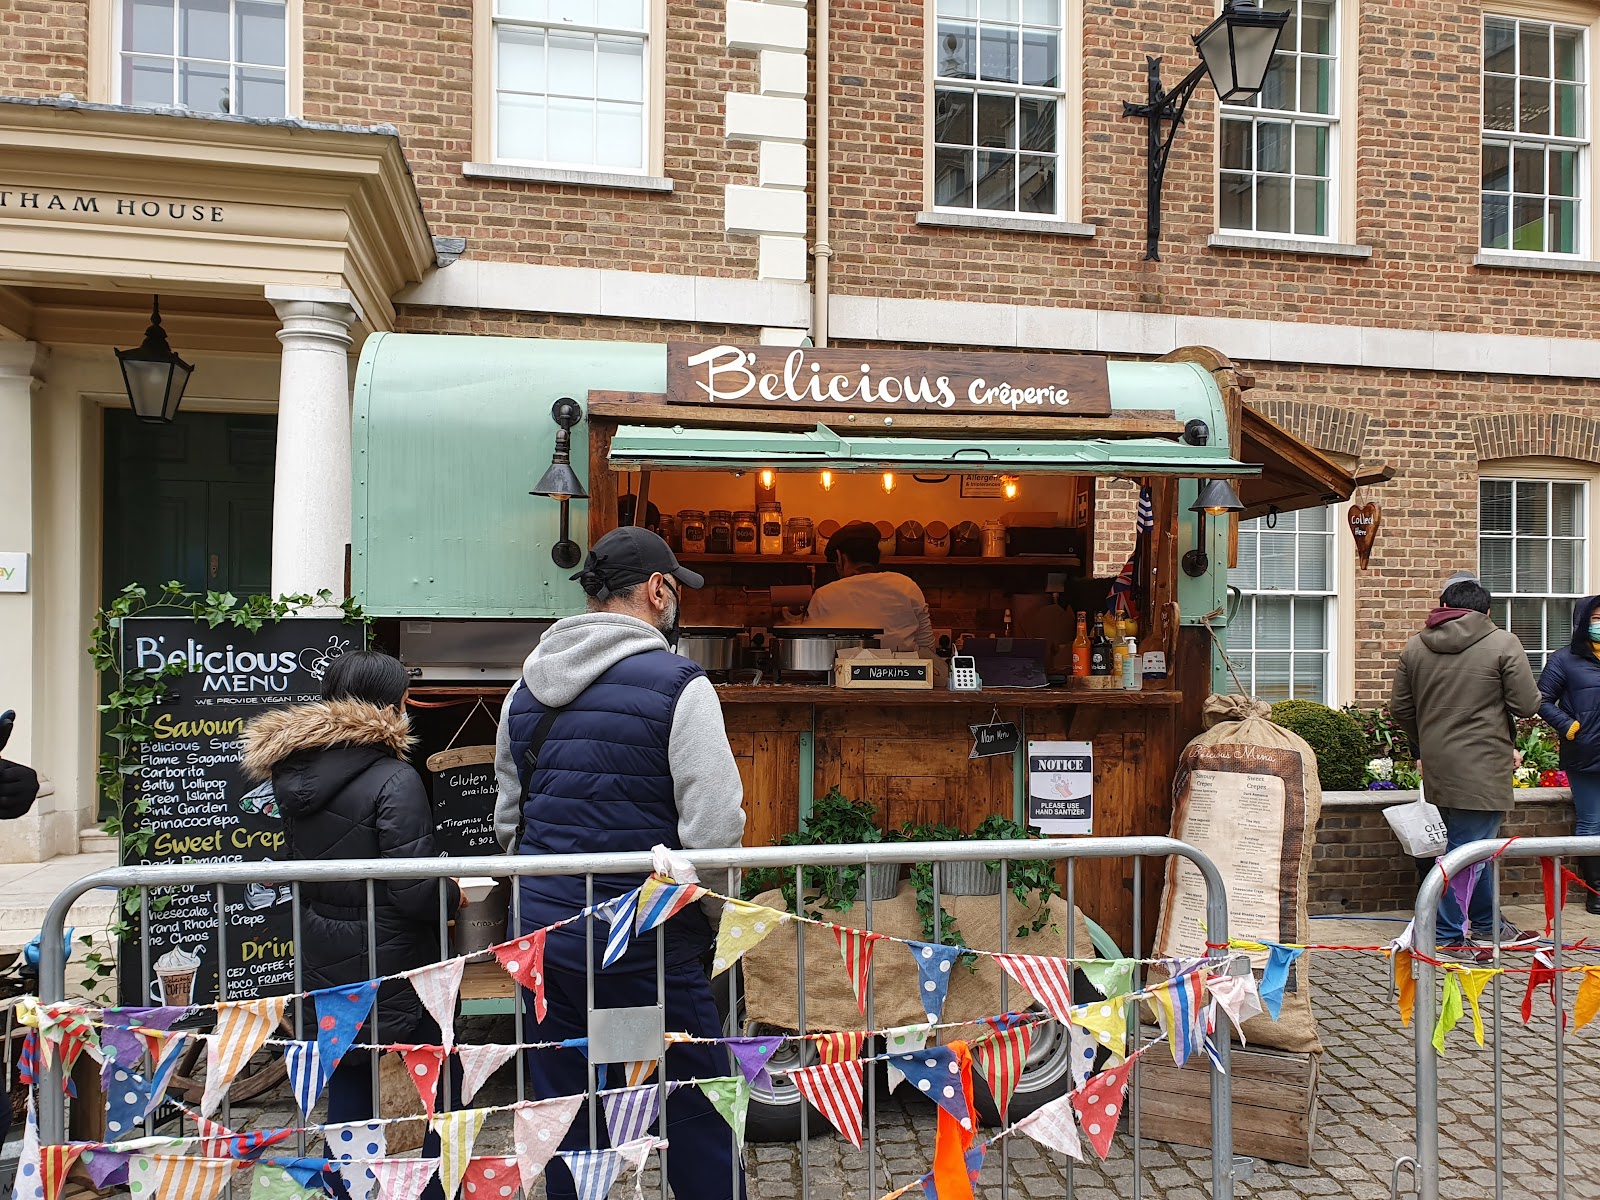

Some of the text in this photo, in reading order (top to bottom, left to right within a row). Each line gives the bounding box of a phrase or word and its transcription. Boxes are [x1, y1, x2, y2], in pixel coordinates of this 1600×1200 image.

[116, 199, 224, 222] HOUSE
[687, 345, 1070, 410] B'elicious Crêperie
[1351, 513, 1374, 525] Collect
[202, 674, 288, 692] MENU
[217, 696, 258, 704] PROVIDE
[260, 695, 292, 703] VEGAN
[297, 693, 322, 703] DOUG
[140, 755, 181, 766] Flame
[1038, 759, 1083, 771] NOTICE
[140, 767, 205, 778] Carborita
[140, 778, 227, 792] Salty Lollipop
[449, 773, 487, 787] Gluten
[141, 789, 225, 805] Green Island
[177, 802, 228, 814] Garden
[443, 817, 482, 828] Tiramisu
[1424, 821, 1445, 832] OLE
[154, 830, 223, 856] Sweet
[171, 891, 212, 906] Forest
[148, 906, 209, 920] heesecake
[149, 913, 266, 934] rand Rhode Crepe
[169, 931, 210, 946] Chaos
[165, 982, 191, 995] COFFEE
[227, 978, 253, 990] HOCO
